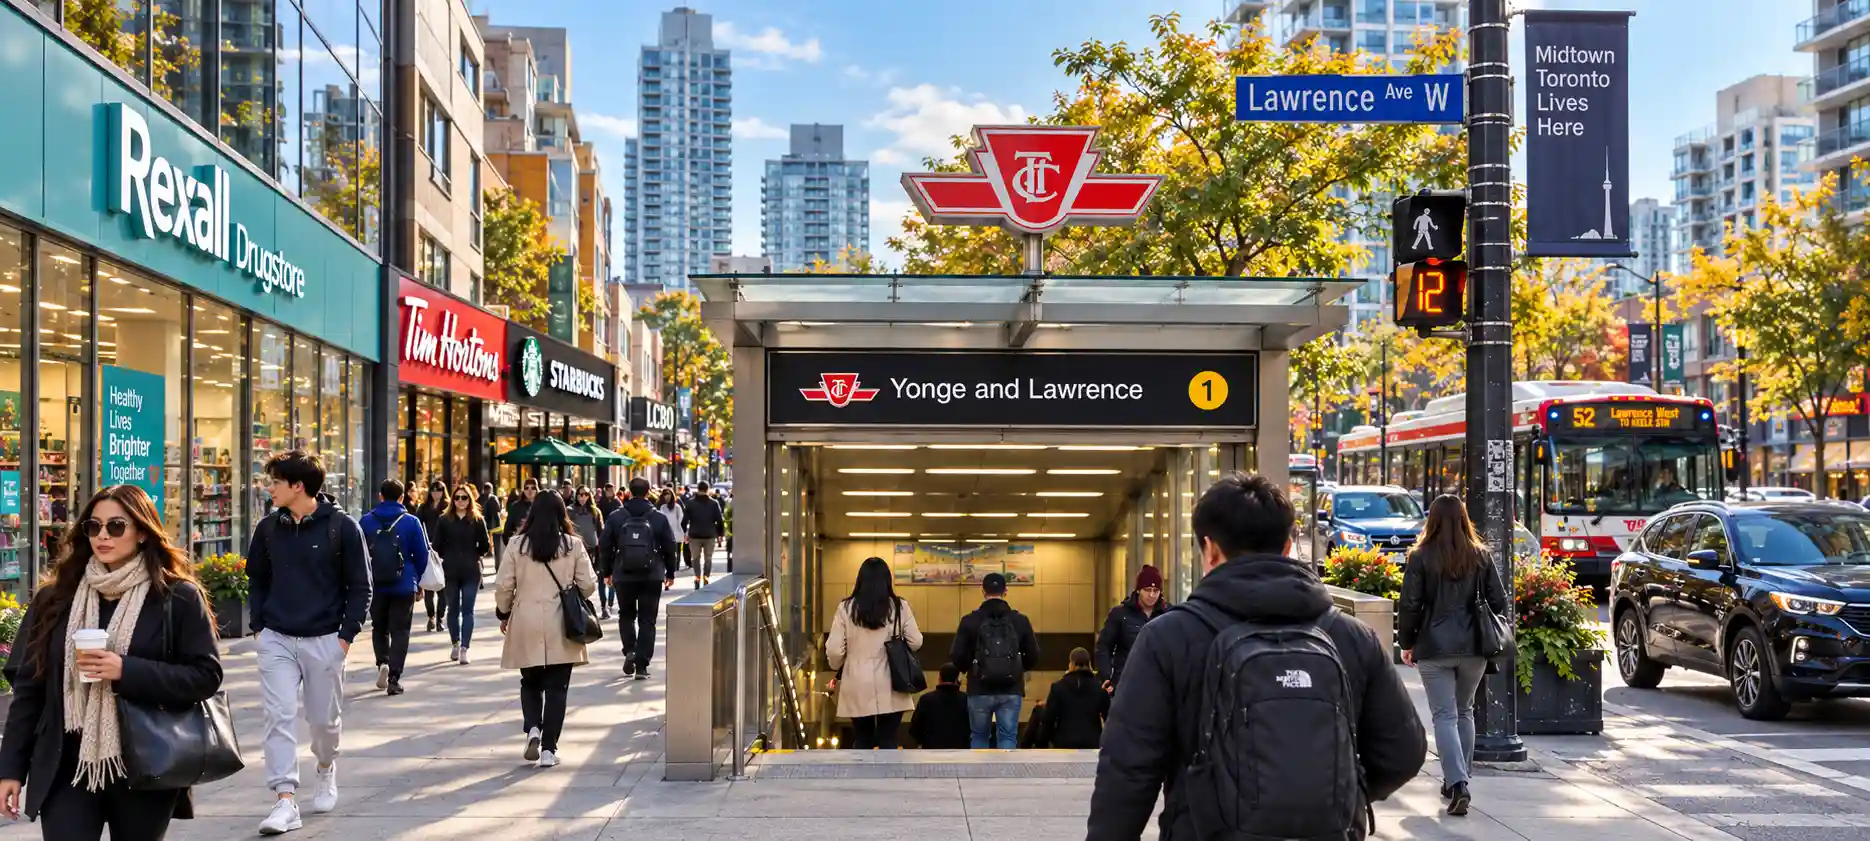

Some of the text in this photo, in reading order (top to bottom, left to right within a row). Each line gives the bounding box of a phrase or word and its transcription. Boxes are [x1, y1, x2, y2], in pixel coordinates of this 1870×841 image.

[1536, 45, 1615, 64] Midtown
[1535, 69, 1610, 88] Toronto
[1249, 82, 1449, 112] Lawrence Ave W
[1537, 93, 1589, 112] Lives
[1537, 117, 1585, 136] Here
[120, 102, 230, 262] Rexall
[236, 222, 306, 298] Drugstore
[1418, 271, 1445, 313] 12
[404, 295, 500, 382] Tim Hortons
[550, 359, 605, 401] STARBUCKS
[890, 377, 1144, 404] Yonge and Lawrence
[1201, 379, 1213, 402] 1
[109, 385, 144, 413] Healthy
[1610, 406, 1653, 419] Lawrence
[109, 409, 132, 431] Lives
[646, 400, 675, 430] LCBO
[1572, 406, 1596, 428] 52
[108, 432, 152, 462] Brighter
[108, 461, 146, 485] Together
